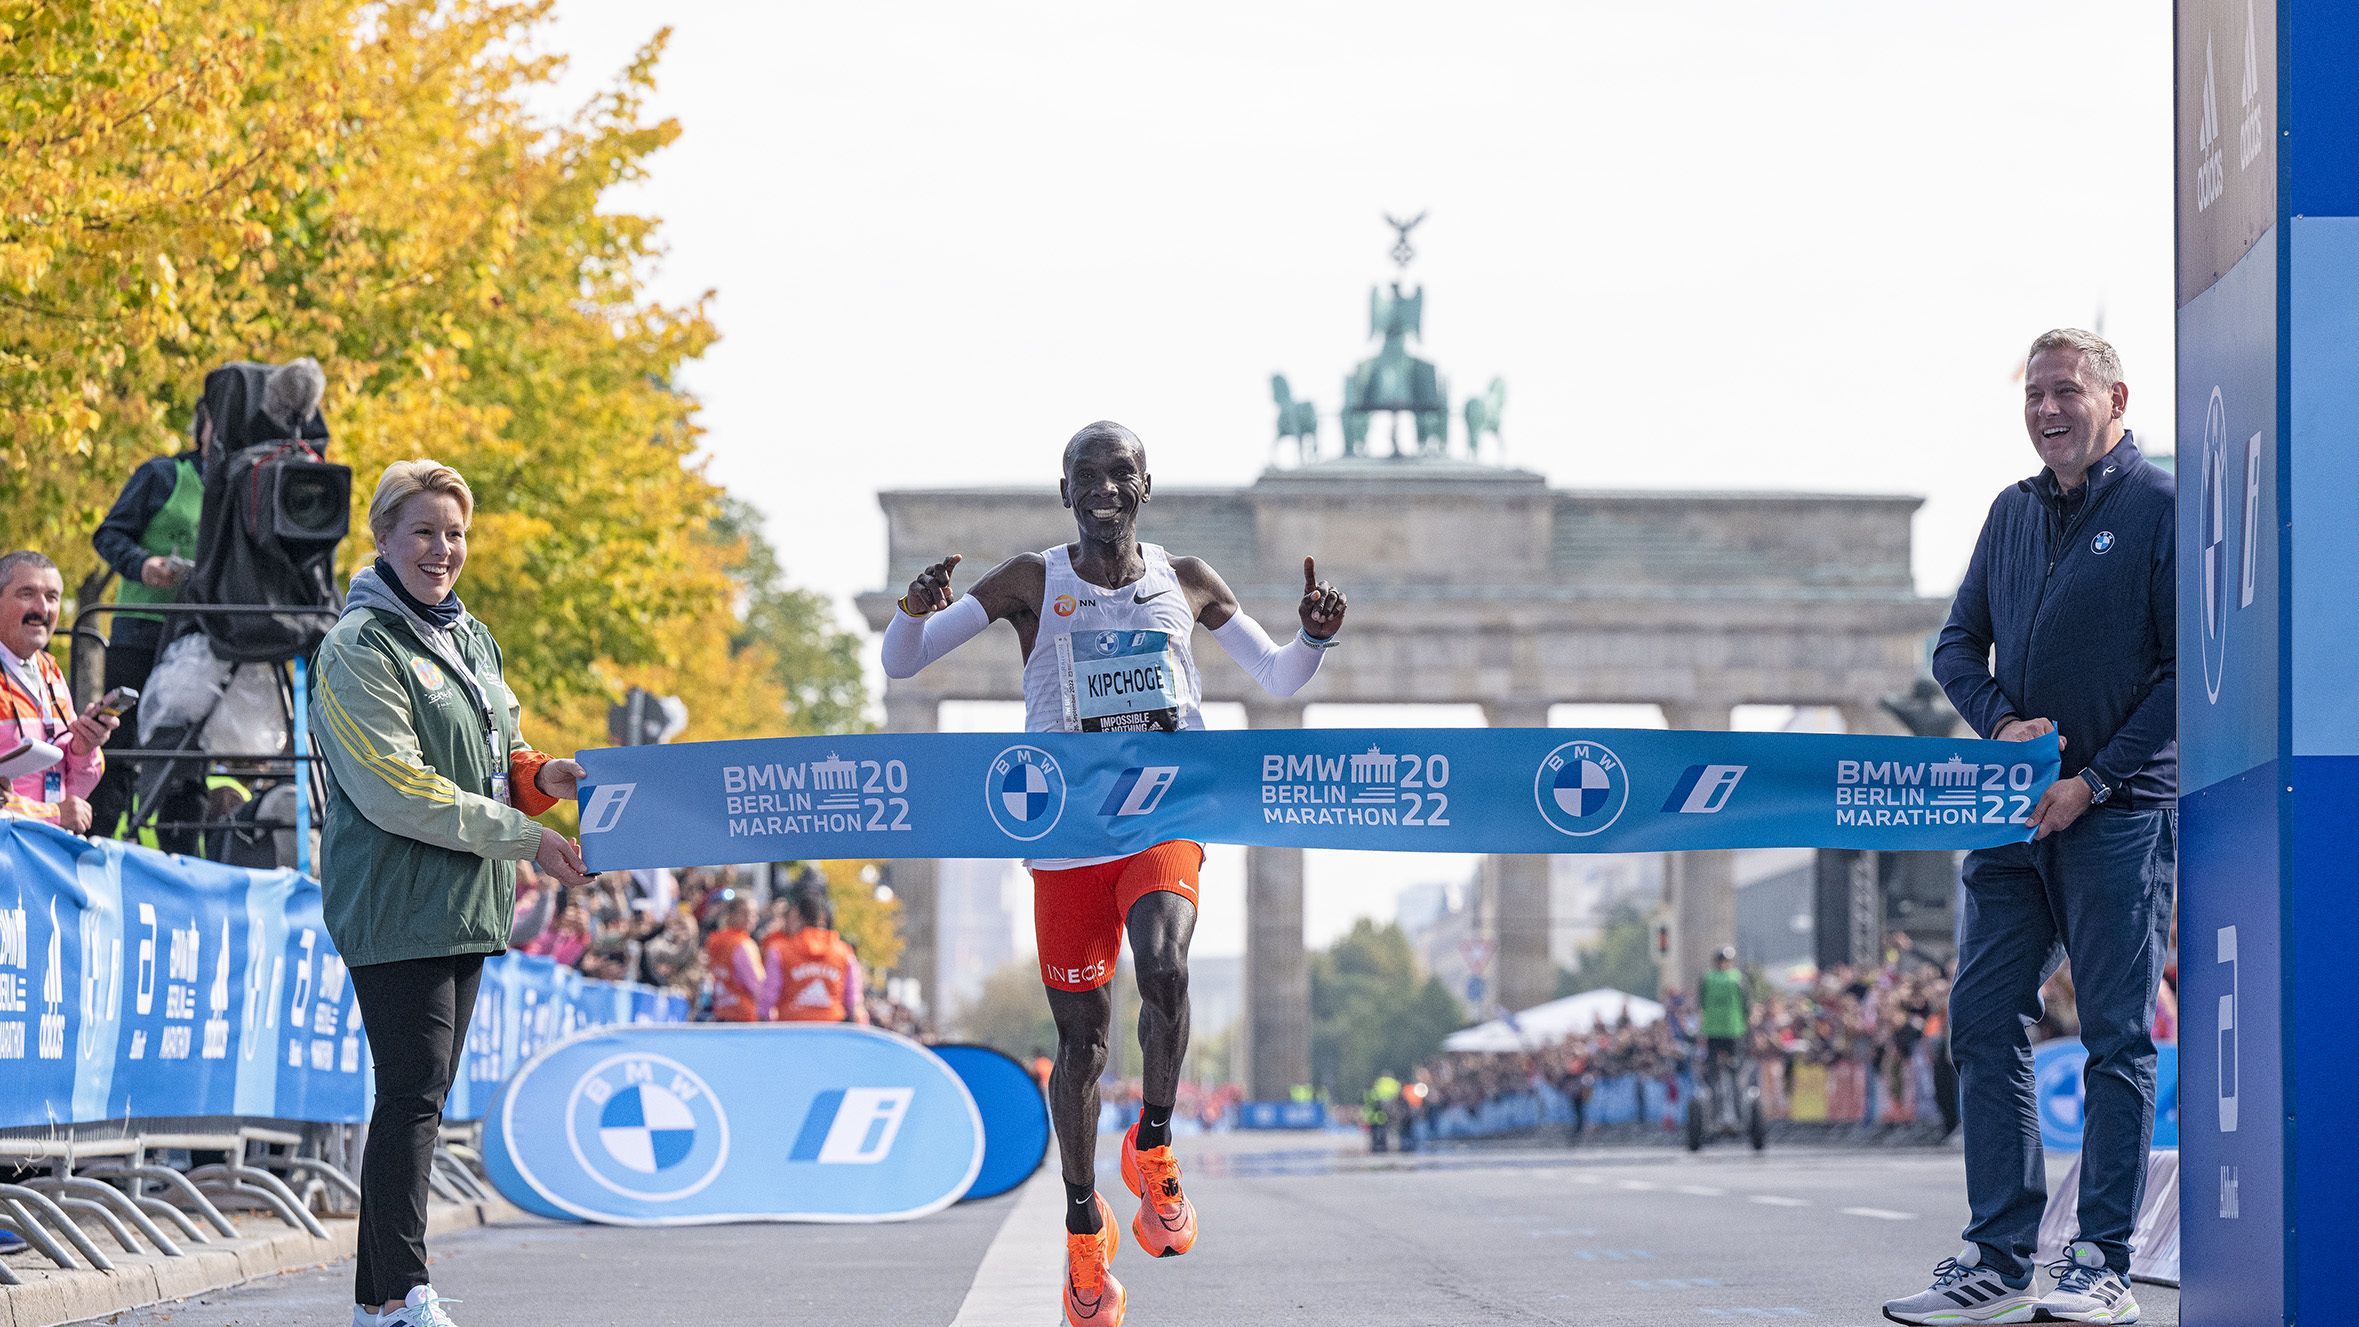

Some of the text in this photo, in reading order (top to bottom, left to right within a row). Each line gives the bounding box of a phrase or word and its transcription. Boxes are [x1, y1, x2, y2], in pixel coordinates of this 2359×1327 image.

[1080, 599, 1096, 607] NN
[1088, 666, 1164, 697] KIPCHOGE
[1100, 712, 1149, 728] IMPOSSIBLE
[995, 750, 1054, 776] BMW
[1262, 754, 1346, 782] BMW
[1400, 754, 1449, 788] 20
[1547, 745, 1617, 772] BMW
[723, 763, 806, 793] BMW
[860, 760, 908, 793] 20
[1837, 760, 1925, 785] BMW
[1981, 763, 2033, 791] 20
[727, 793, 811, 815] BERLIN
[1262, 785, 1346, 804] BERLIN
[1836, 787, 1924, 806] BERLIN
[864, 797, 912, 831] 22
[1263, 807, 1397, 826] MARATHON
[1402, 793, 1450, 826] 22
[1836, 808, 1977, 826] MARATHON
[1981, 795, 2032, 824] 22
[728, 814, 862, 837] MARATHON
[1046, 959, 1105, 984] INEOS
[585, 1060, 701, 1106] BMW
